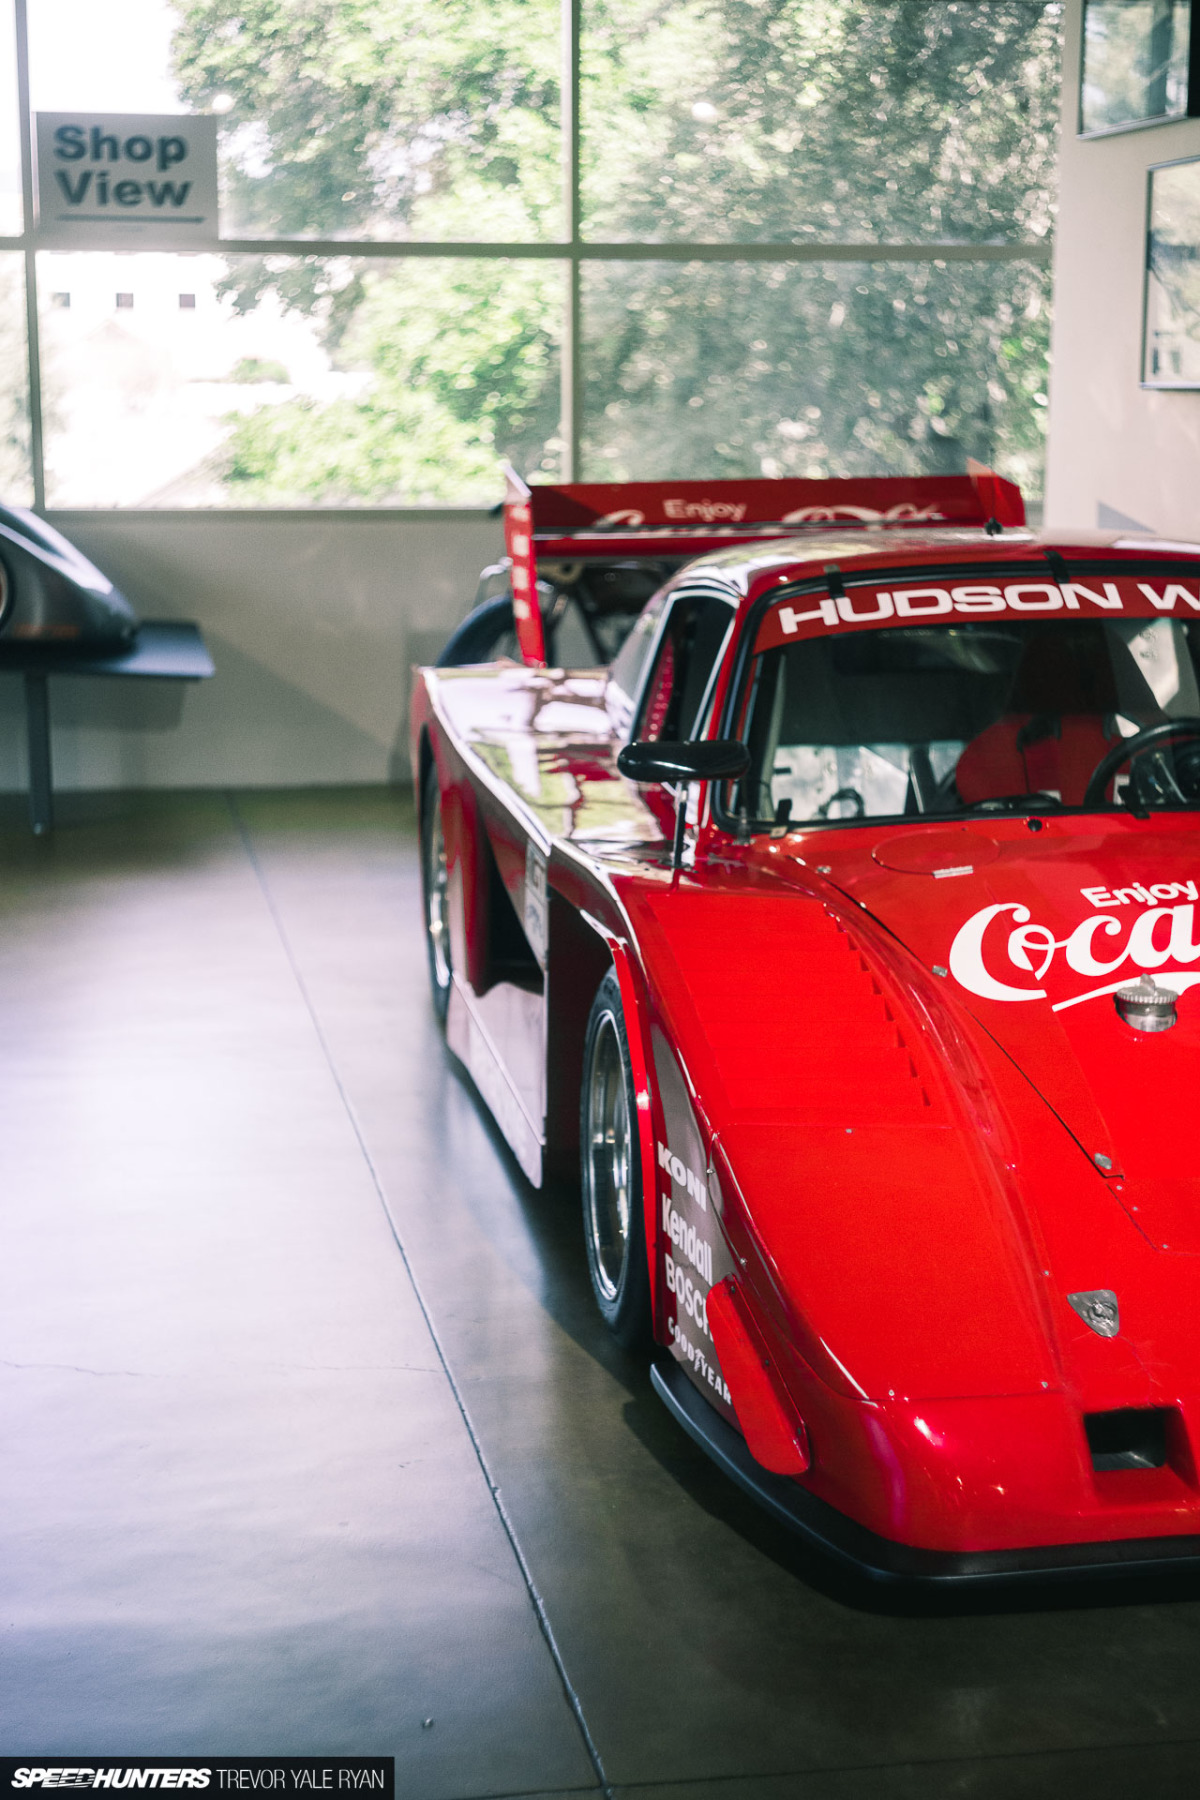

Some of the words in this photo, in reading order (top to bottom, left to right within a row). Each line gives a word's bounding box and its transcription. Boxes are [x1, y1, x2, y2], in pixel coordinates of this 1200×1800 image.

[53, 124, 188, 172] Shop
[54, 169, 194, 207] View
[662, 498, 747, 522] Enjoy
[778, 583, 1123, 635] HUDSON
[1080, 880, 1199, 908] Enjoy
[657, 1140, 707, 1212] KONI
[661, 1192, 714, 1287] Kendall
